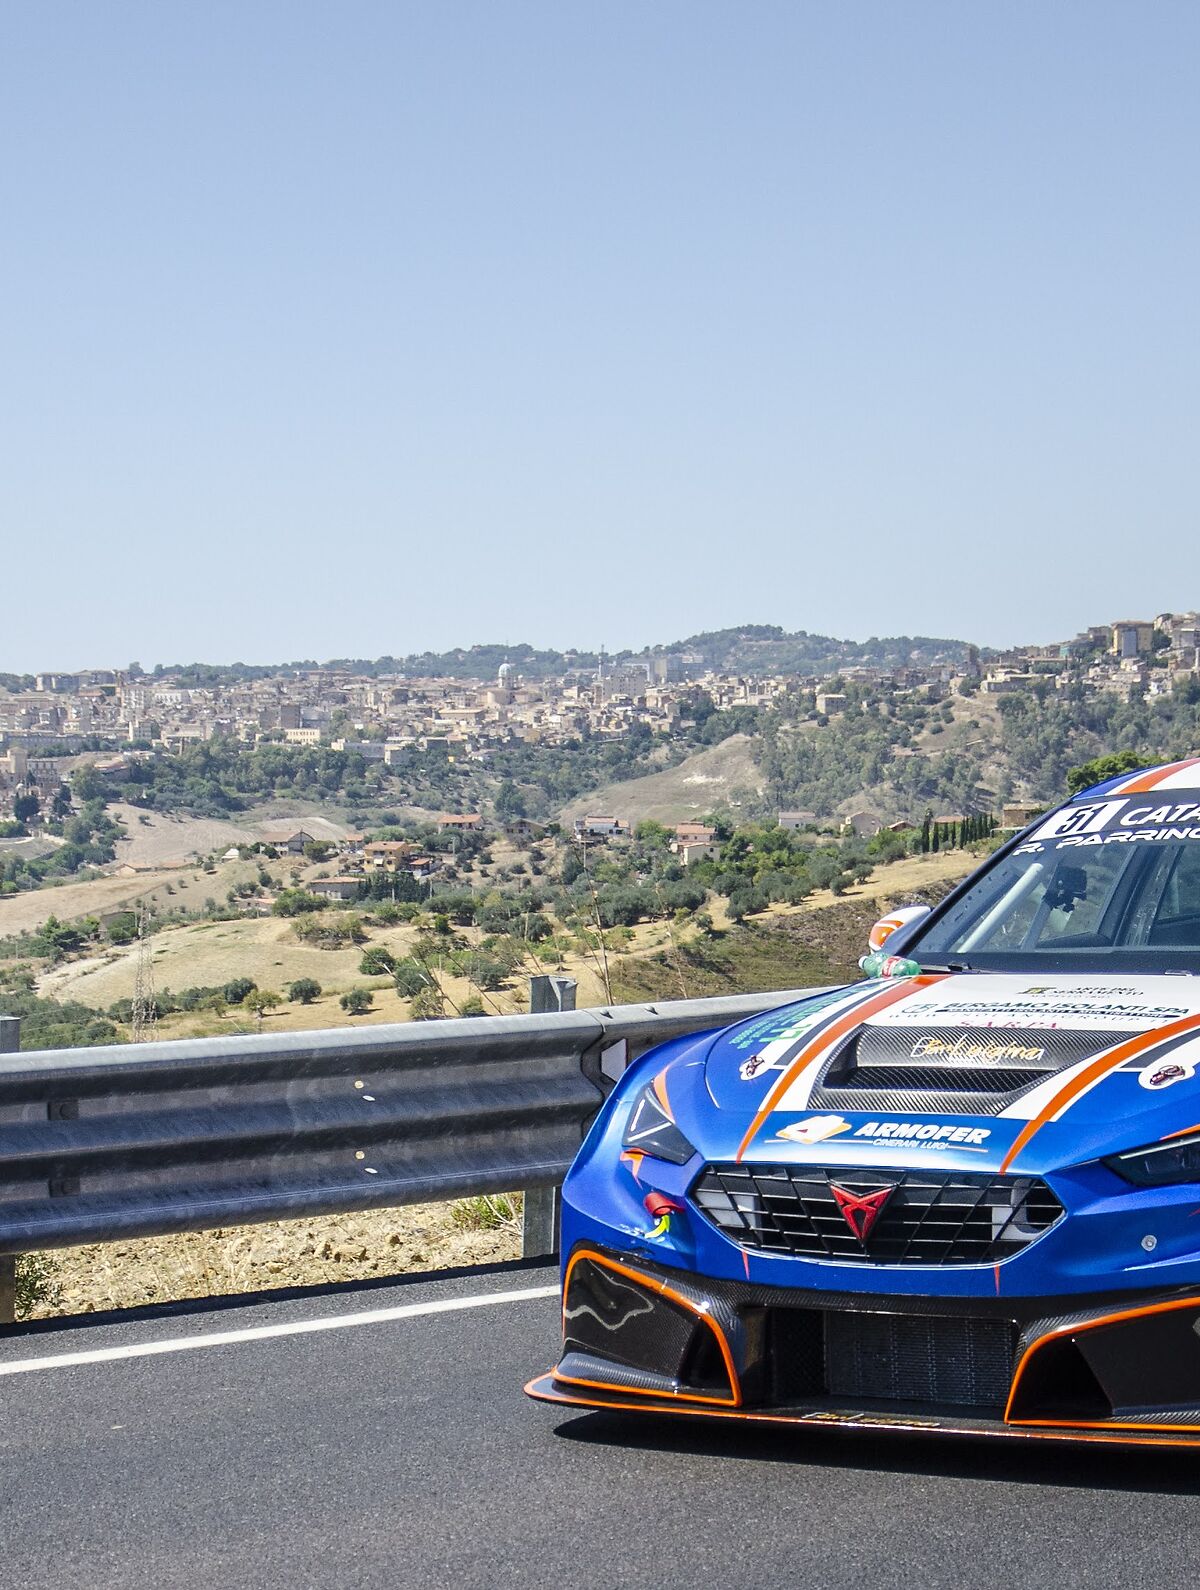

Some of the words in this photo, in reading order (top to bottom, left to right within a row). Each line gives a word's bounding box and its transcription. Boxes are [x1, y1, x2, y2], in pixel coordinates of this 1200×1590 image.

[1058, 805, 1100, 836] 51
[1054, 1002, 1148, 1012] ISOLANTI
[853, 1122, 992, 1145] ARMOFER
[920, 1140, 949, 1150] LUIGI
